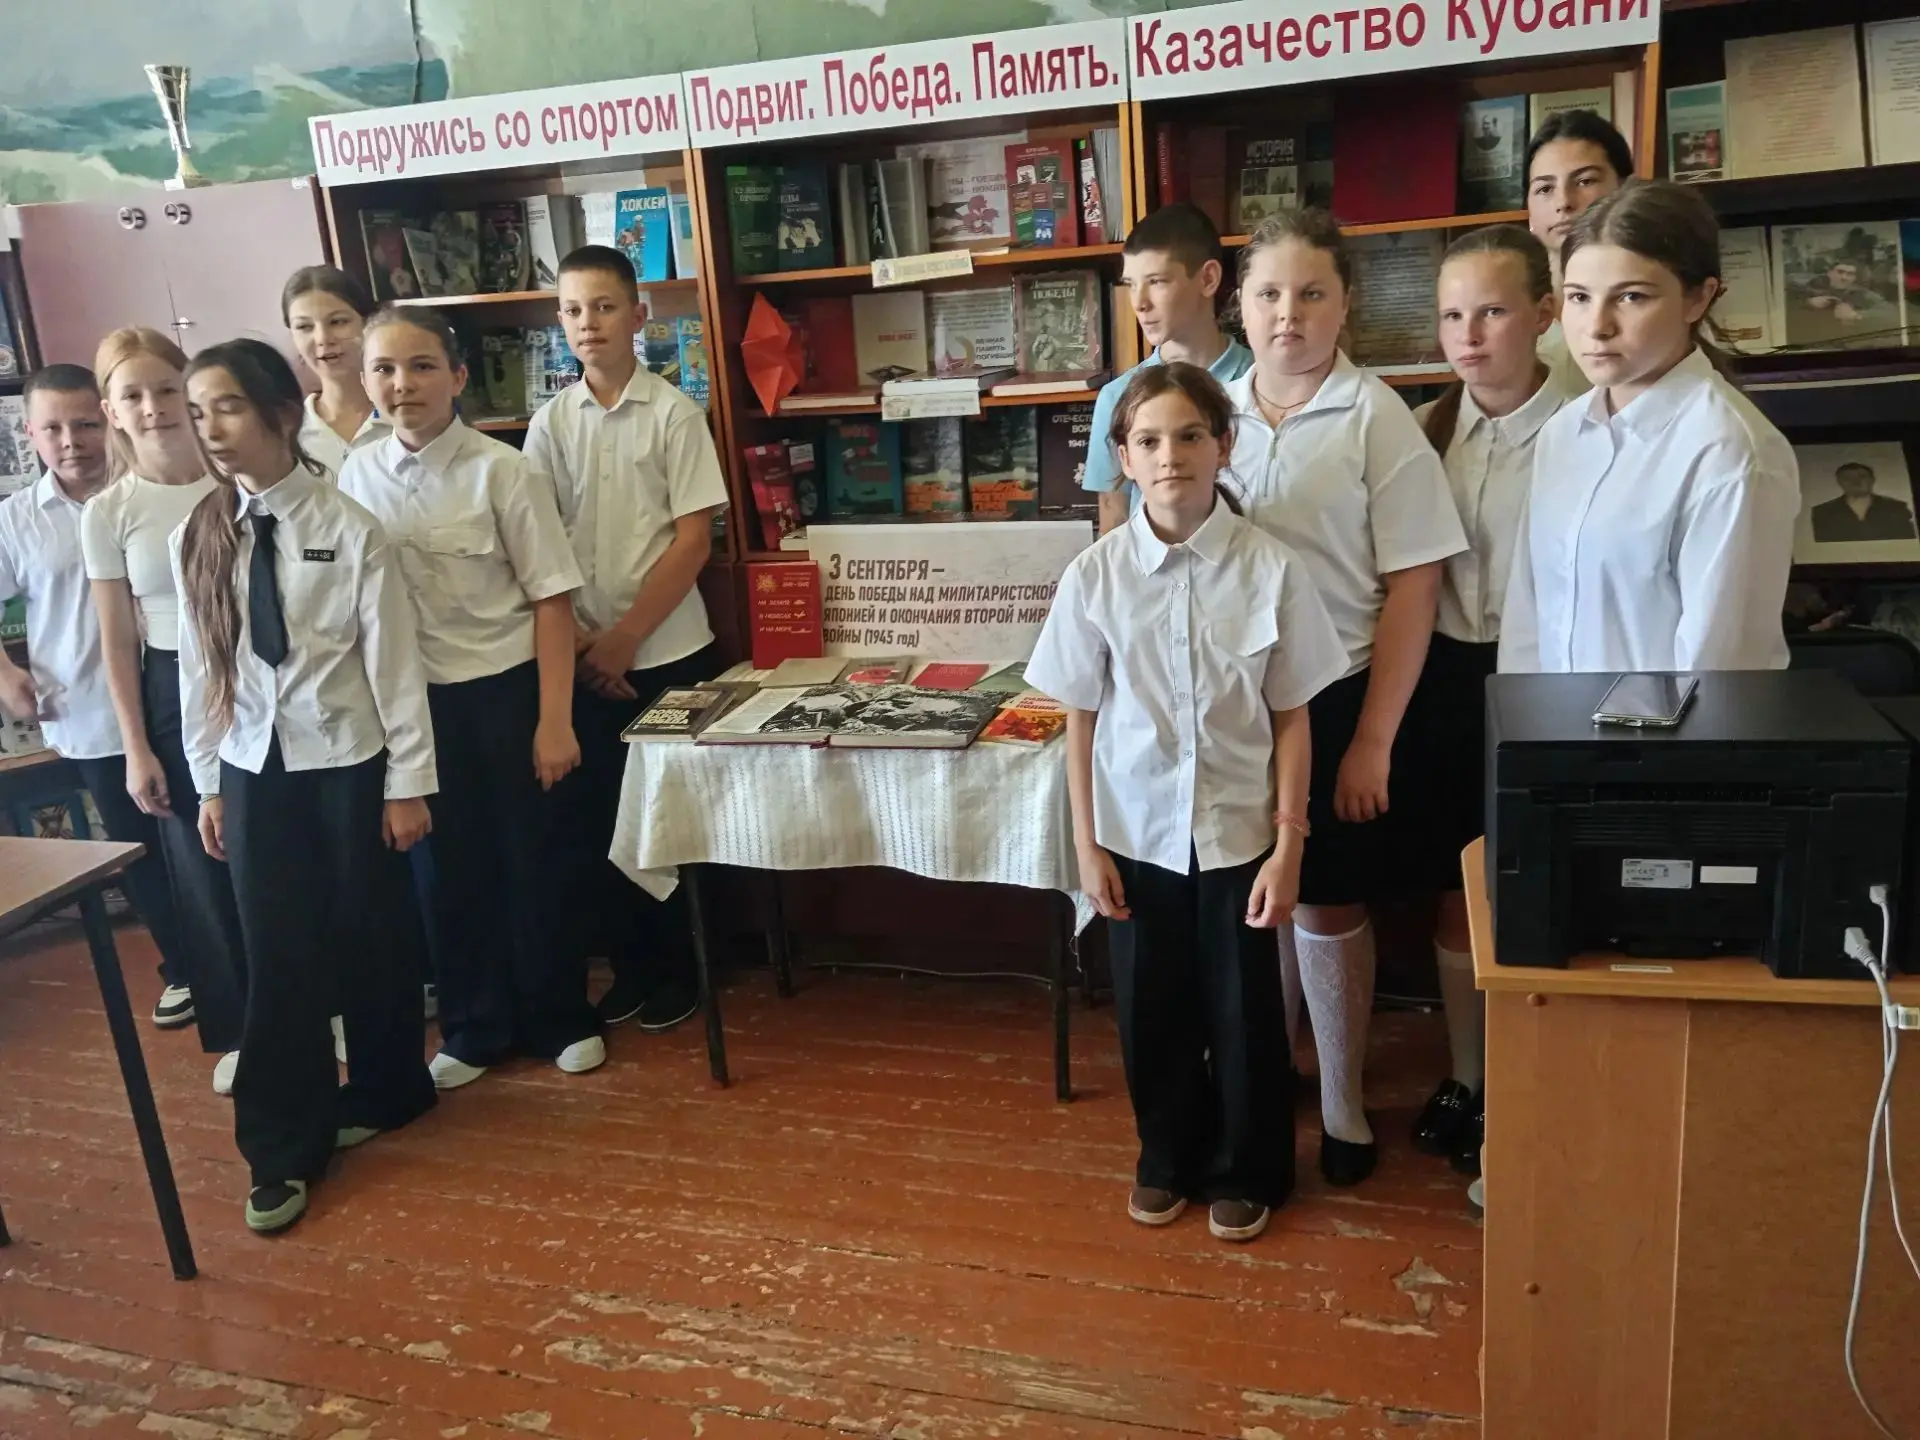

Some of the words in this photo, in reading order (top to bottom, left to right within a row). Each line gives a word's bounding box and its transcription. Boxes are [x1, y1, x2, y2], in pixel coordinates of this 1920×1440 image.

[1135, 5, 1425, 77] Казачество
[1447, 0, 1649, 54] Кубани
[691, 76, 815, 137] Подвиг.
[824, 53, 961, 118] Победа.
[972, 41, 1119, 100] Память.
[314, 117, 486, 174] Подружись
[495, 111, 531, 150] со
[541, 93, 679, 151] спортом
[620, 193, 667, 213] ХОККЕЙ
[829, 553, 842, 581] 3
[847, 559, 929, 582] СЕНТЯБРЯ
[825, 586, 855, 604] ДЕНЬ
[858, 586, 906, 604] ПОБЕДЫ
[909, 586, 935, 605] НАД
[823, 604, 875, 624] ЯПОНИЕЙ
[878, 608, 887, 623] И
[890, 607, 961, 625] ОКОНЧАНИЯ
[964, 603, 1014, 624] ВТОРОЙ
[822, 628, 862, 645] ВОЙНЫ
[864, 629, 894, 647] (1945
[896, 630, 920, 648] год)
